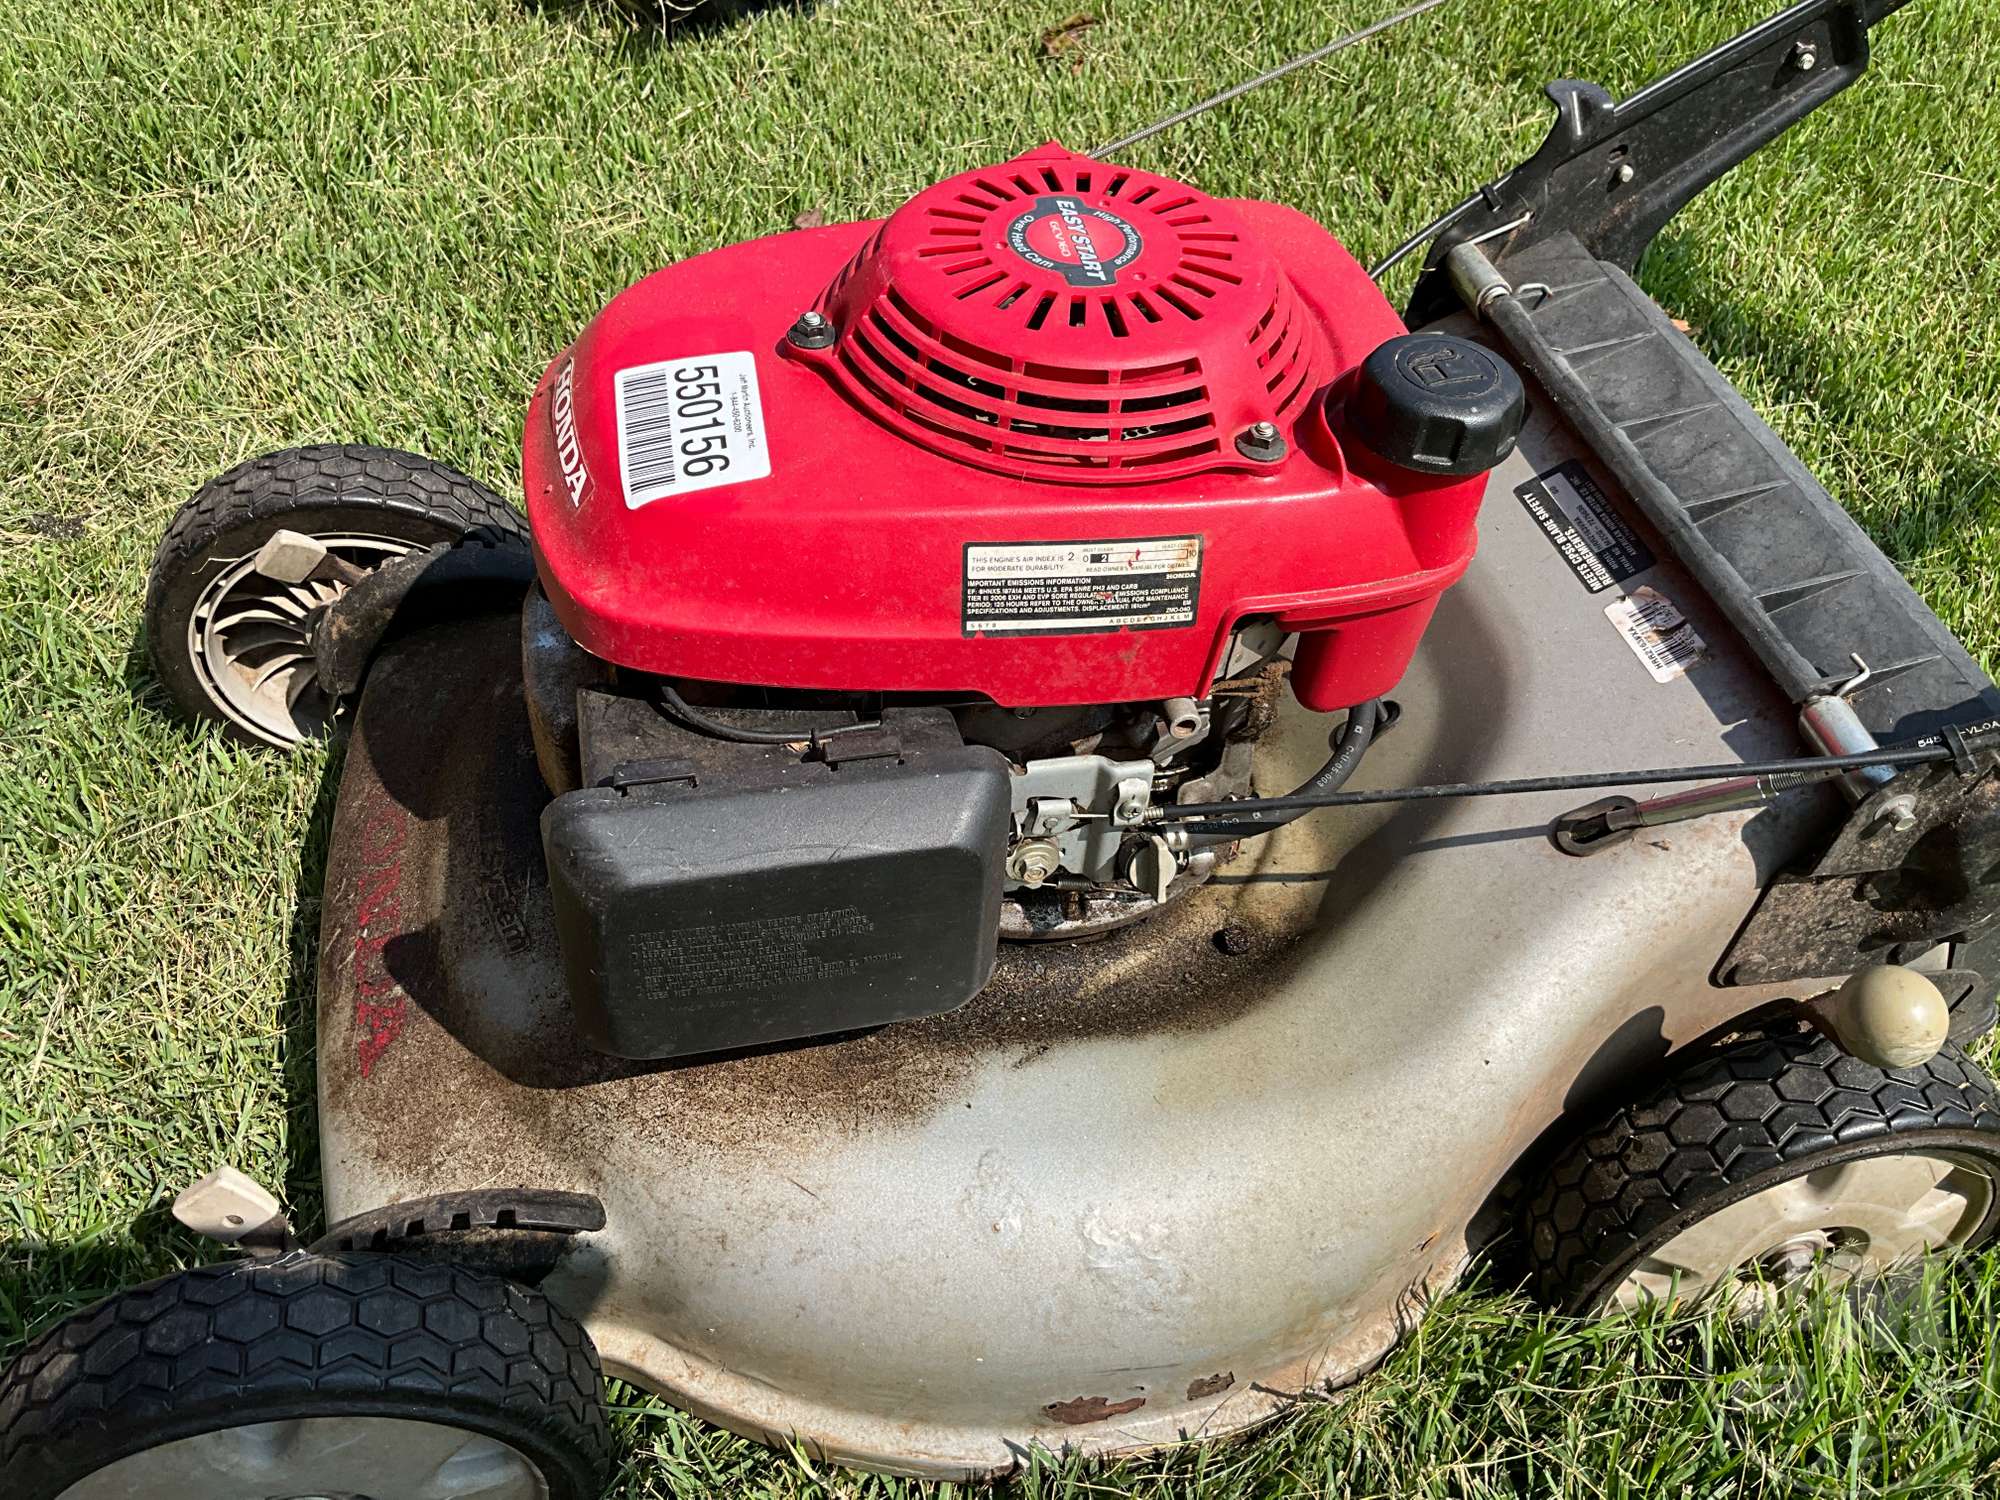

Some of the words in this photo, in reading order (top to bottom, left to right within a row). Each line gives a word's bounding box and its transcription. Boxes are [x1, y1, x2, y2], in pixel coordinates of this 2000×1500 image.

[1012, 215, 1034, 233] Over
[1011, 232, 1029, 254] Head
[1056, 200, 1086, 235] EASY
[1071, 235, 1106, 281] START
[1093, 211, 1121, 224] High
[1114, 222, 1139, 265] Performance
[1025, 252, 1054, 268] Cam
[674, 365, 729, 476] 550156
[554, 362, 587, 508] HONDA
[1521, 491, 1549, 520] SAFETY
[1542, 517, 1567, 544] BLADE
[1067, 551, 1074, 560] 2
[1101, 554, 1107, 562] 2
[1560, 541, 1583, 565] CPSC
[1562, 524, 1614, 586] REQUIREMENTS.
[1617, 554, 1635, 573] SERIAL
[967, 579, 1006, 588] IMPORTANT
[1007, 578, 1044, 587] EMISSIONS
[1045, 577, 1091, 585] INFORMATION
[1575, 562, 1603, 591] MEETS
[1145, 593, 1188, 601] MAINTENANCE
[967, 606, 1017, 615] SPECIFICATIONS
[1033, 605, 1080, 613] ADJUSTMENTS.
